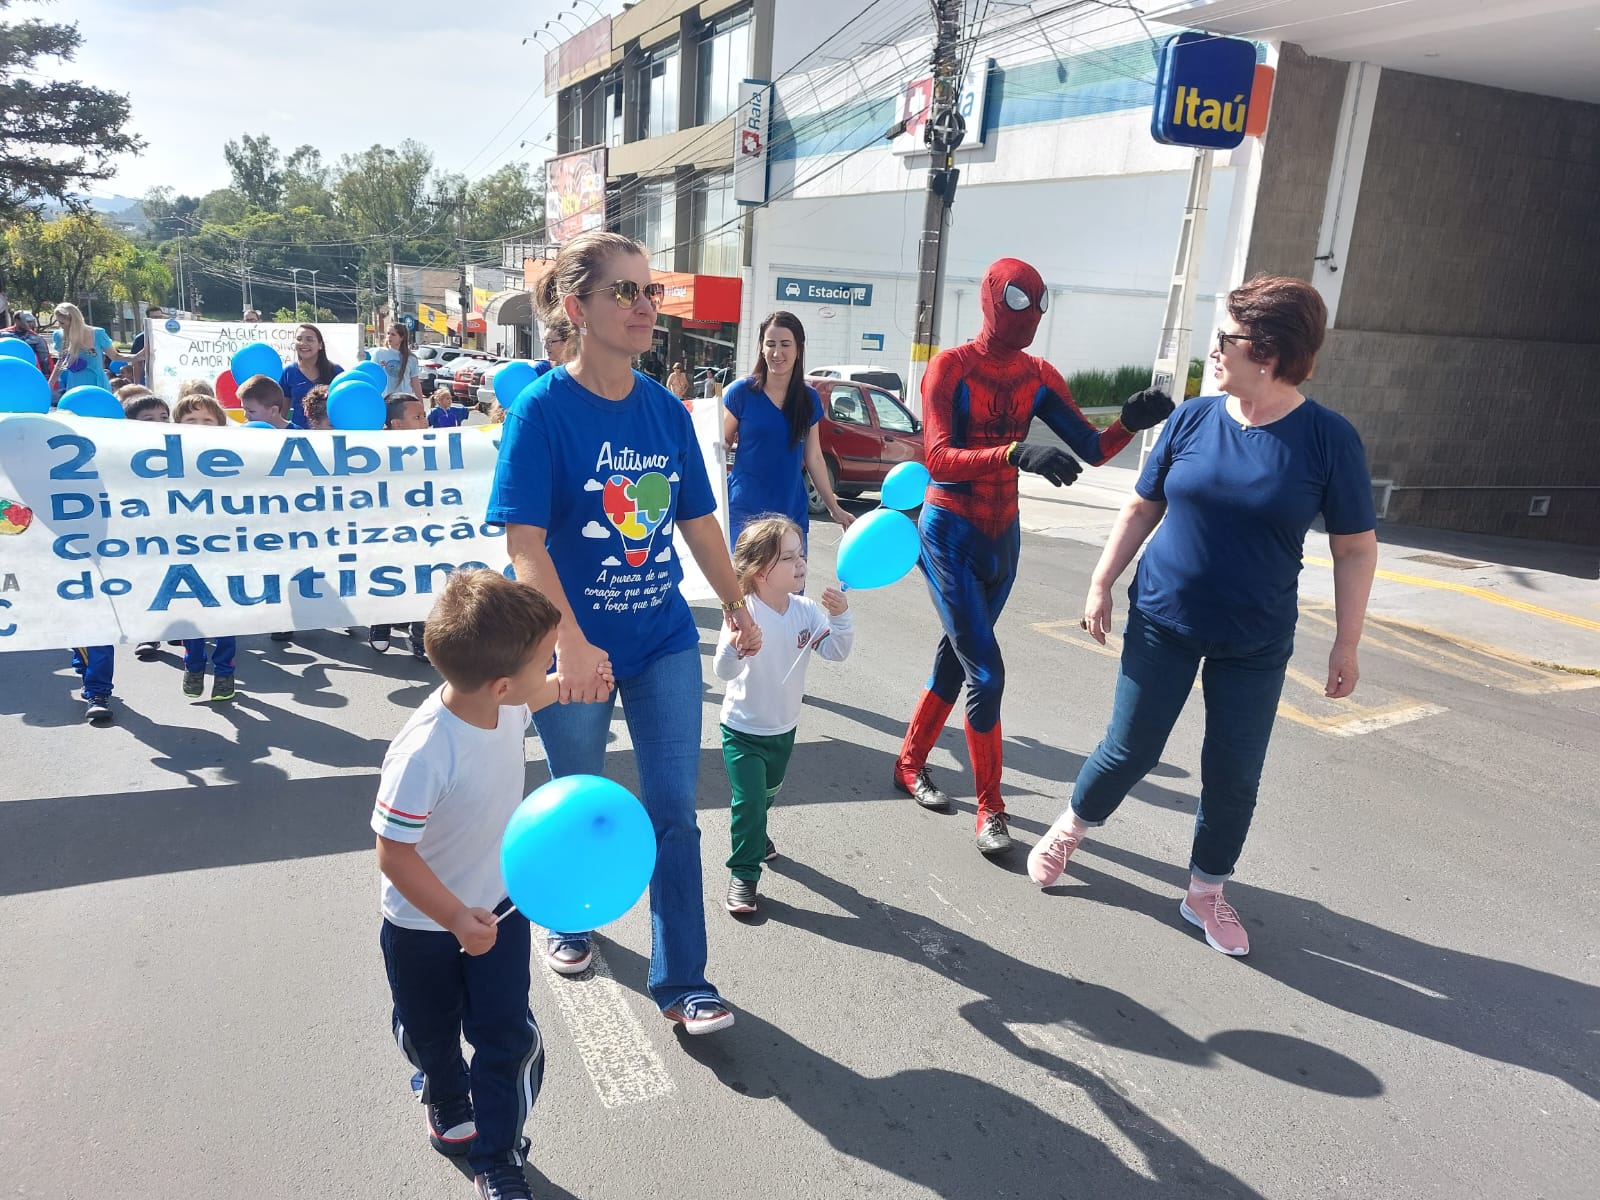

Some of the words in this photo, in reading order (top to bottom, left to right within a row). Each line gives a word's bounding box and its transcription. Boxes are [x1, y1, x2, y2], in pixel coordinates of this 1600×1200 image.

[748, 92, 761, 130] Raia
[1173, 85, 1246, 132] Itaú
[188, 340, 238, 353] AUTISMO
[192, 354, 222, 367] AMOR
[46, 434, 99, 480] 2
[130, 434, 244, 478] de
[267, 432, 464, 478] Abril
[596, 442, 669, 472] Autismo
[50, 492, 150, 521] Dia
[167, 481, 389, 514] Mundial
[404, 481, 463, 507] da
[52, 516, 506, 561] Conscientização
[56, 571, 132, 600] do
[596, 569, 607, 583] A
[610, 573, 642, 587] pureza
[645, 569, 656, 582] de
[584, 587, 622, 600] coração
[624, 588, 641, 602] que
[644, 584, 659, 595] não
[604, 598, 629, 613] força
[632, 601, 648, 615] que
